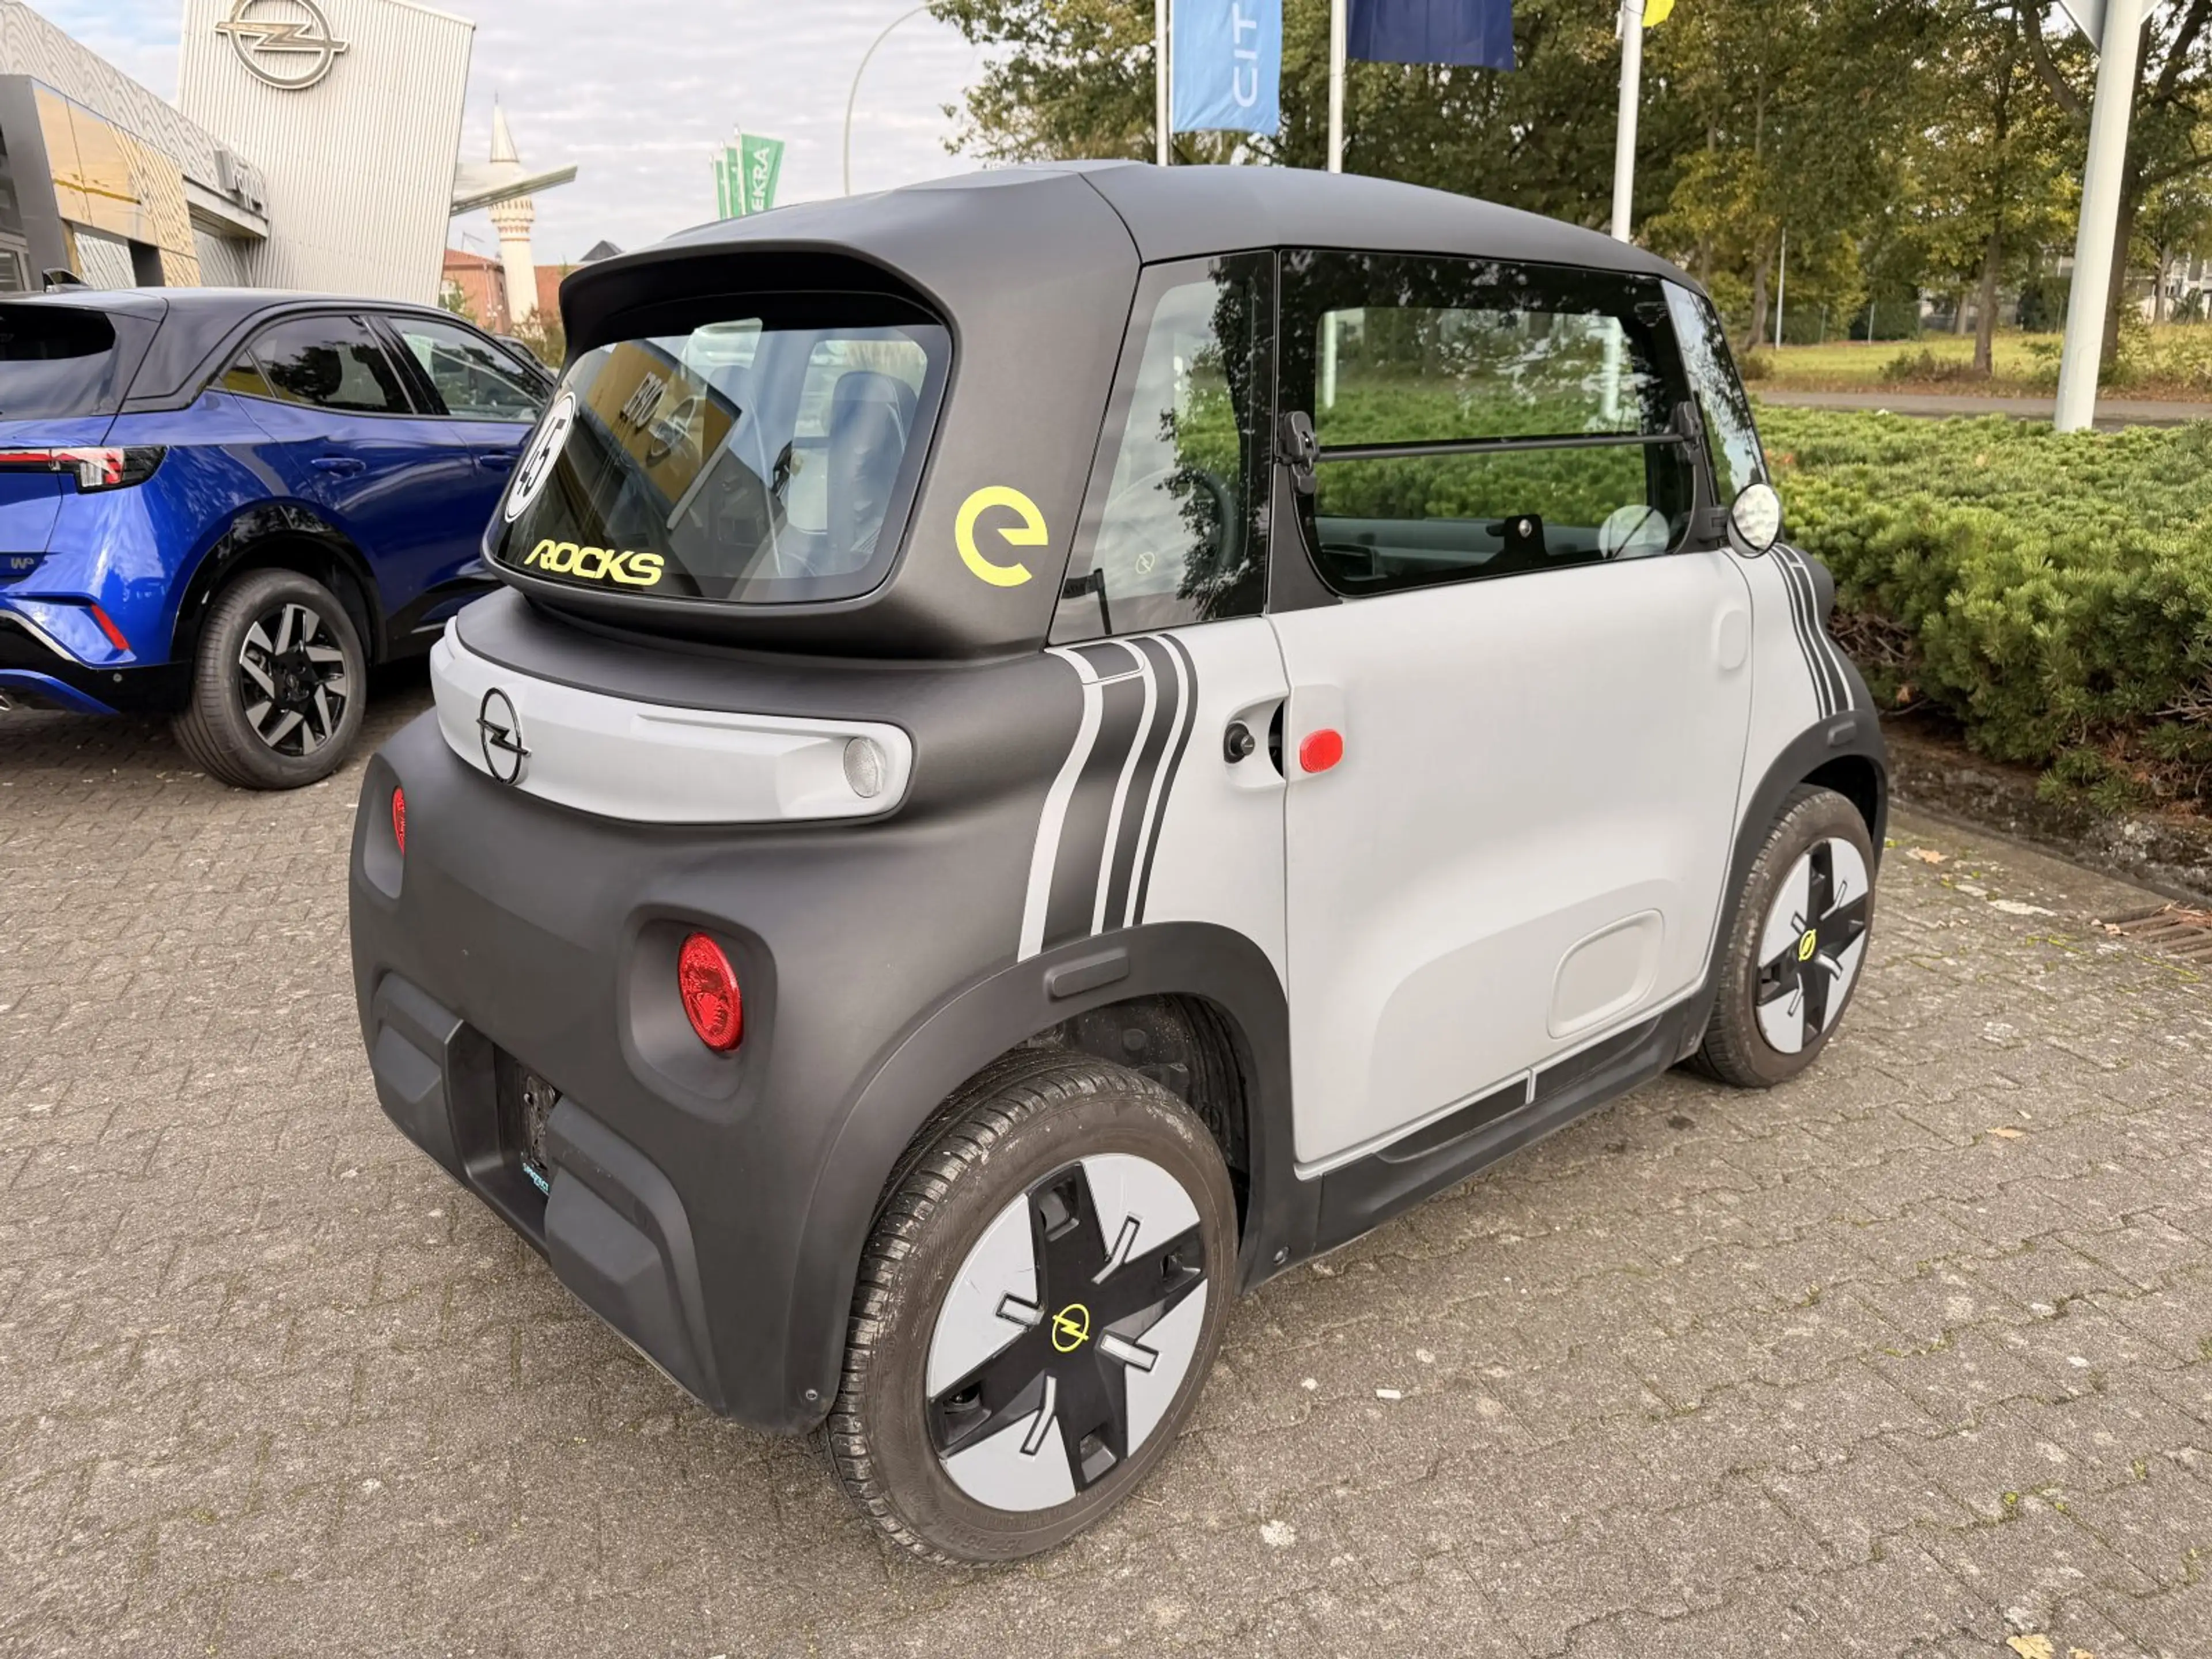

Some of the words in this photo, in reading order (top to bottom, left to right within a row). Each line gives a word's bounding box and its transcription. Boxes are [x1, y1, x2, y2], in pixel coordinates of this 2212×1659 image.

[1232, 2, 1258, 108] CIT
[517, 417, 567, 498] 45
[524, 539, 664, 586] ROCKS
[955, 485, 1049, 588] e
